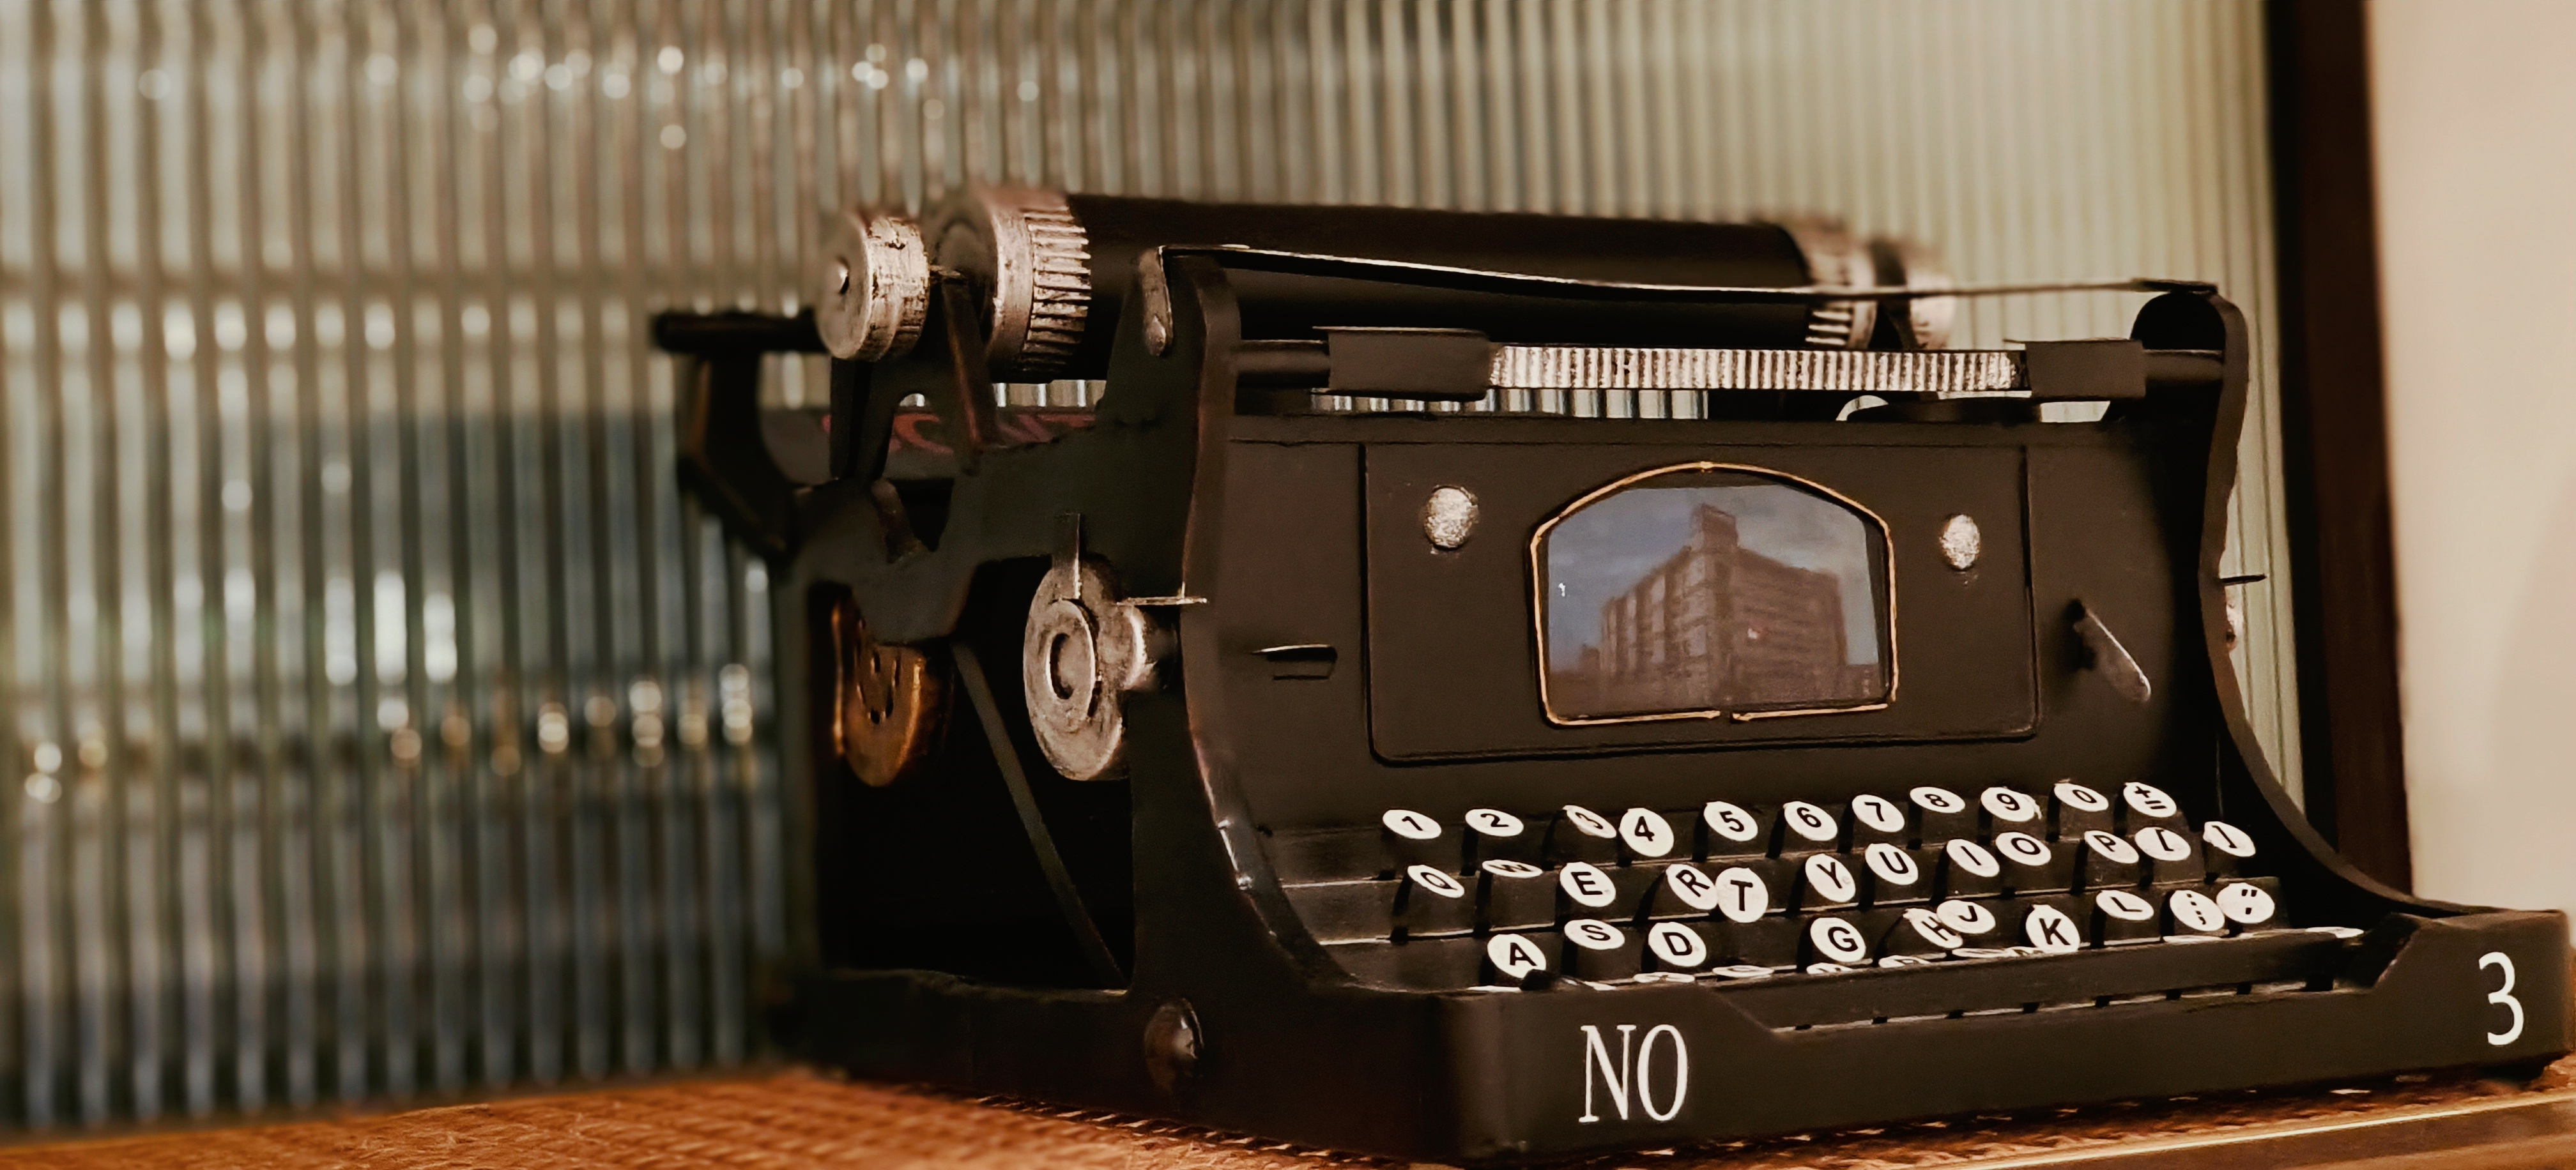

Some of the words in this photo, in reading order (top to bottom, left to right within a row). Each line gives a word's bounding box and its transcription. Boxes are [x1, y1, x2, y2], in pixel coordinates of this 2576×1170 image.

[1402, 816, 1423, 832] 1
[1480, 813, 1509, 828] 2
[1575, 812, 1604, 830] 3
[1634, 816, 1655, 842] 4
[1720, 810, 1745, 833] 5
[1797, 807, 1822, 828] 6
[1864, 802, 1885, 822] 7
[1924, 793, 1950, 808] 8
[1996, 793, 2021, 811] 9
[1420, 872, 1457, 890] Q
[1570, 871, 1603, 895] E
[1675, 869, 1710, 898] R
[1729, 879, 1754, 912] T
[1816, 862, 1843, 889] Y
[1878, 851, 1909, 874] U
[1960, 846, 1982, 866] I
[2010, 837, 2041, 855] O
[2092, 834, 2117, 853] P
[1509, 942, 1537, 967] A
[1580, 924, 1611, 941] S
[1662, 932, 1693, 956] D
[1827, 926, 1859, 952] G
[1921, 916, 1957, 941] H
[1958, 905, 1979, 923] J
[2039, 918, 2071, 946] K
[2110, 896, 2143, 913] L
[1578, 1024, 1688, 1123] NO
[2478, 952, 2524, 1045] 3
